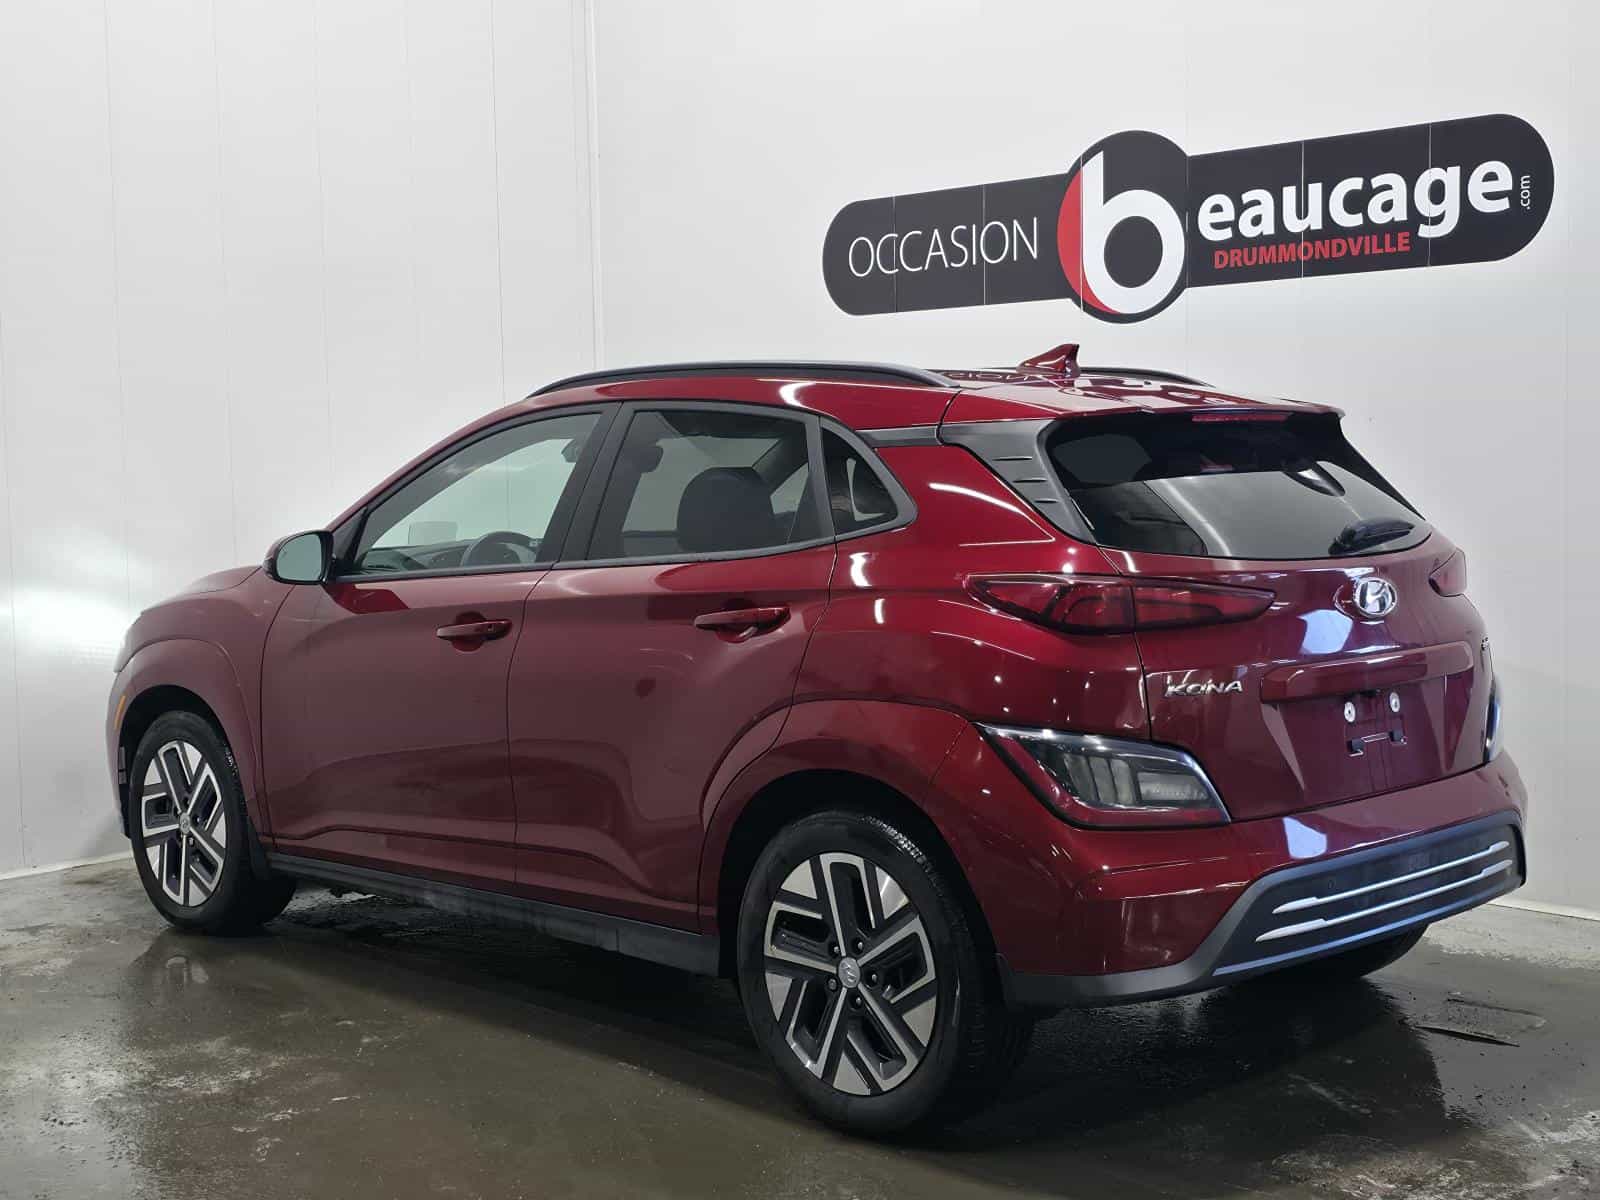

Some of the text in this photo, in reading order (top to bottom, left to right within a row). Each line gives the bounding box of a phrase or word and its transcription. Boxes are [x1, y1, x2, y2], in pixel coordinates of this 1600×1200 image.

[1520, 175, 1531, 210] .com
[848, 216, 1038, 277] OCCASION
[1213, 231, 1411, 269] DRUMMONDVILLE
[1164, 671, 1243, 697] KONA
